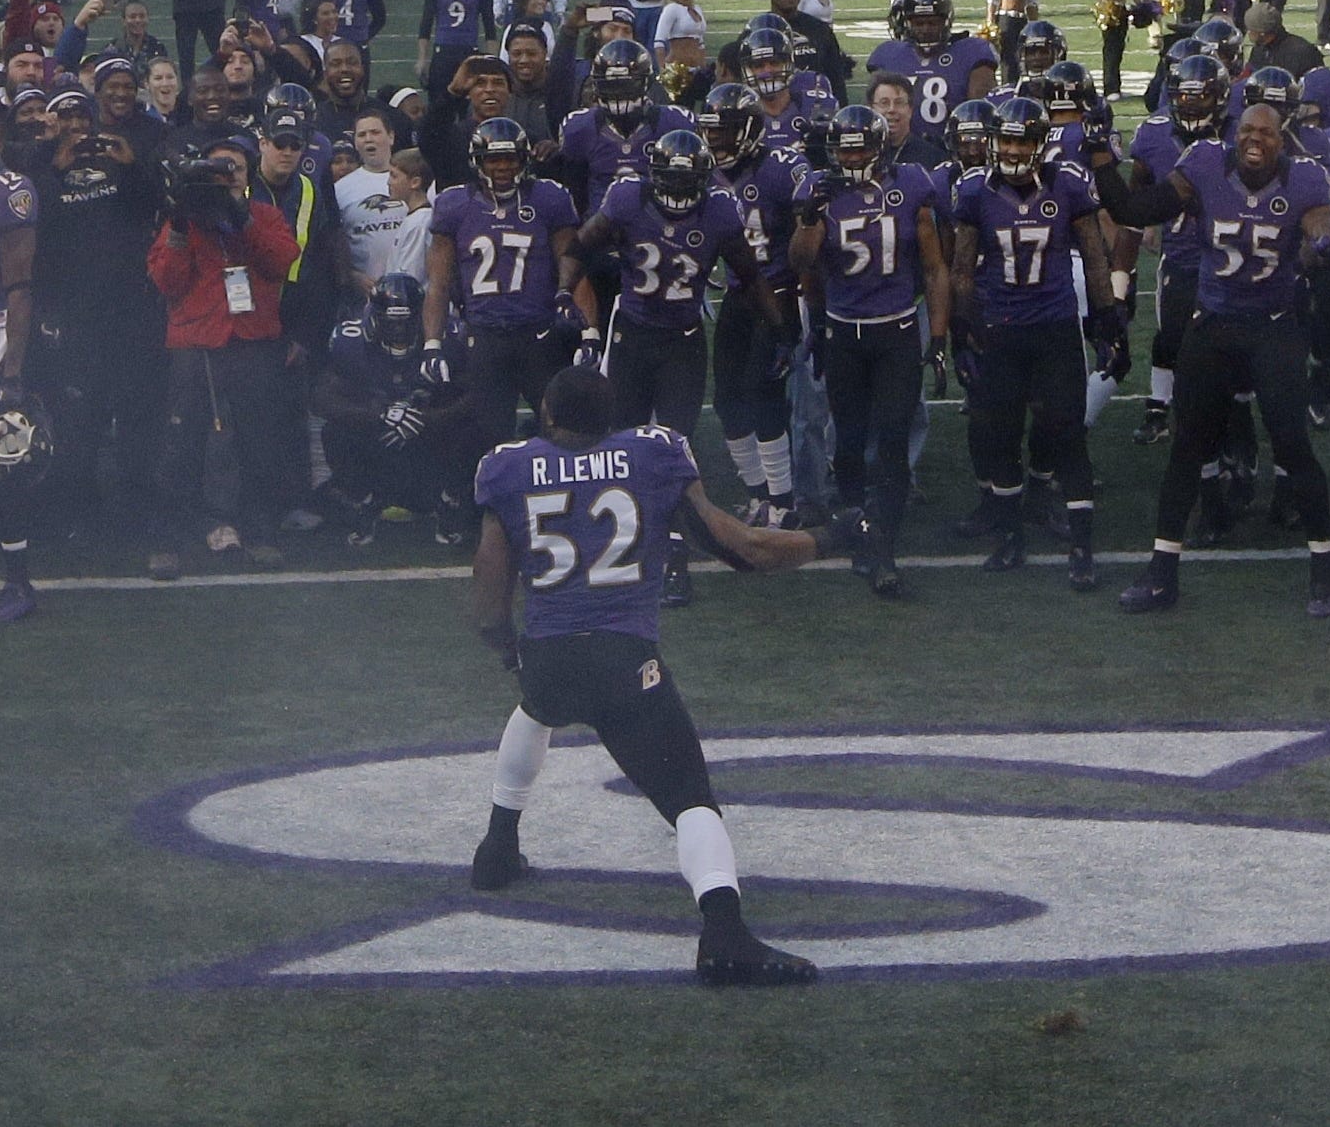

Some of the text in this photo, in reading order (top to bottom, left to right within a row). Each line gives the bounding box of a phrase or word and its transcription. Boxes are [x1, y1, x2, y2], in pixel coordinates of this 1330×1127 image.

[447, 1, 466, 28] 9
[59, 184, 118, 204] RAVENS
[354, 220, 404, 235] RAVEN
[744, 208, 770, 262] 4
[839, 215, 896, 276] 51
[996, 227, 1051, 284] 17
[1213, 222, 1281, 282] 55
[470, 233, 533, 296] 27
[633, 243, 699, 300] 32
[532, 450, 630, 486] R. LEWIS
[525, 485, 643, 588] 52
